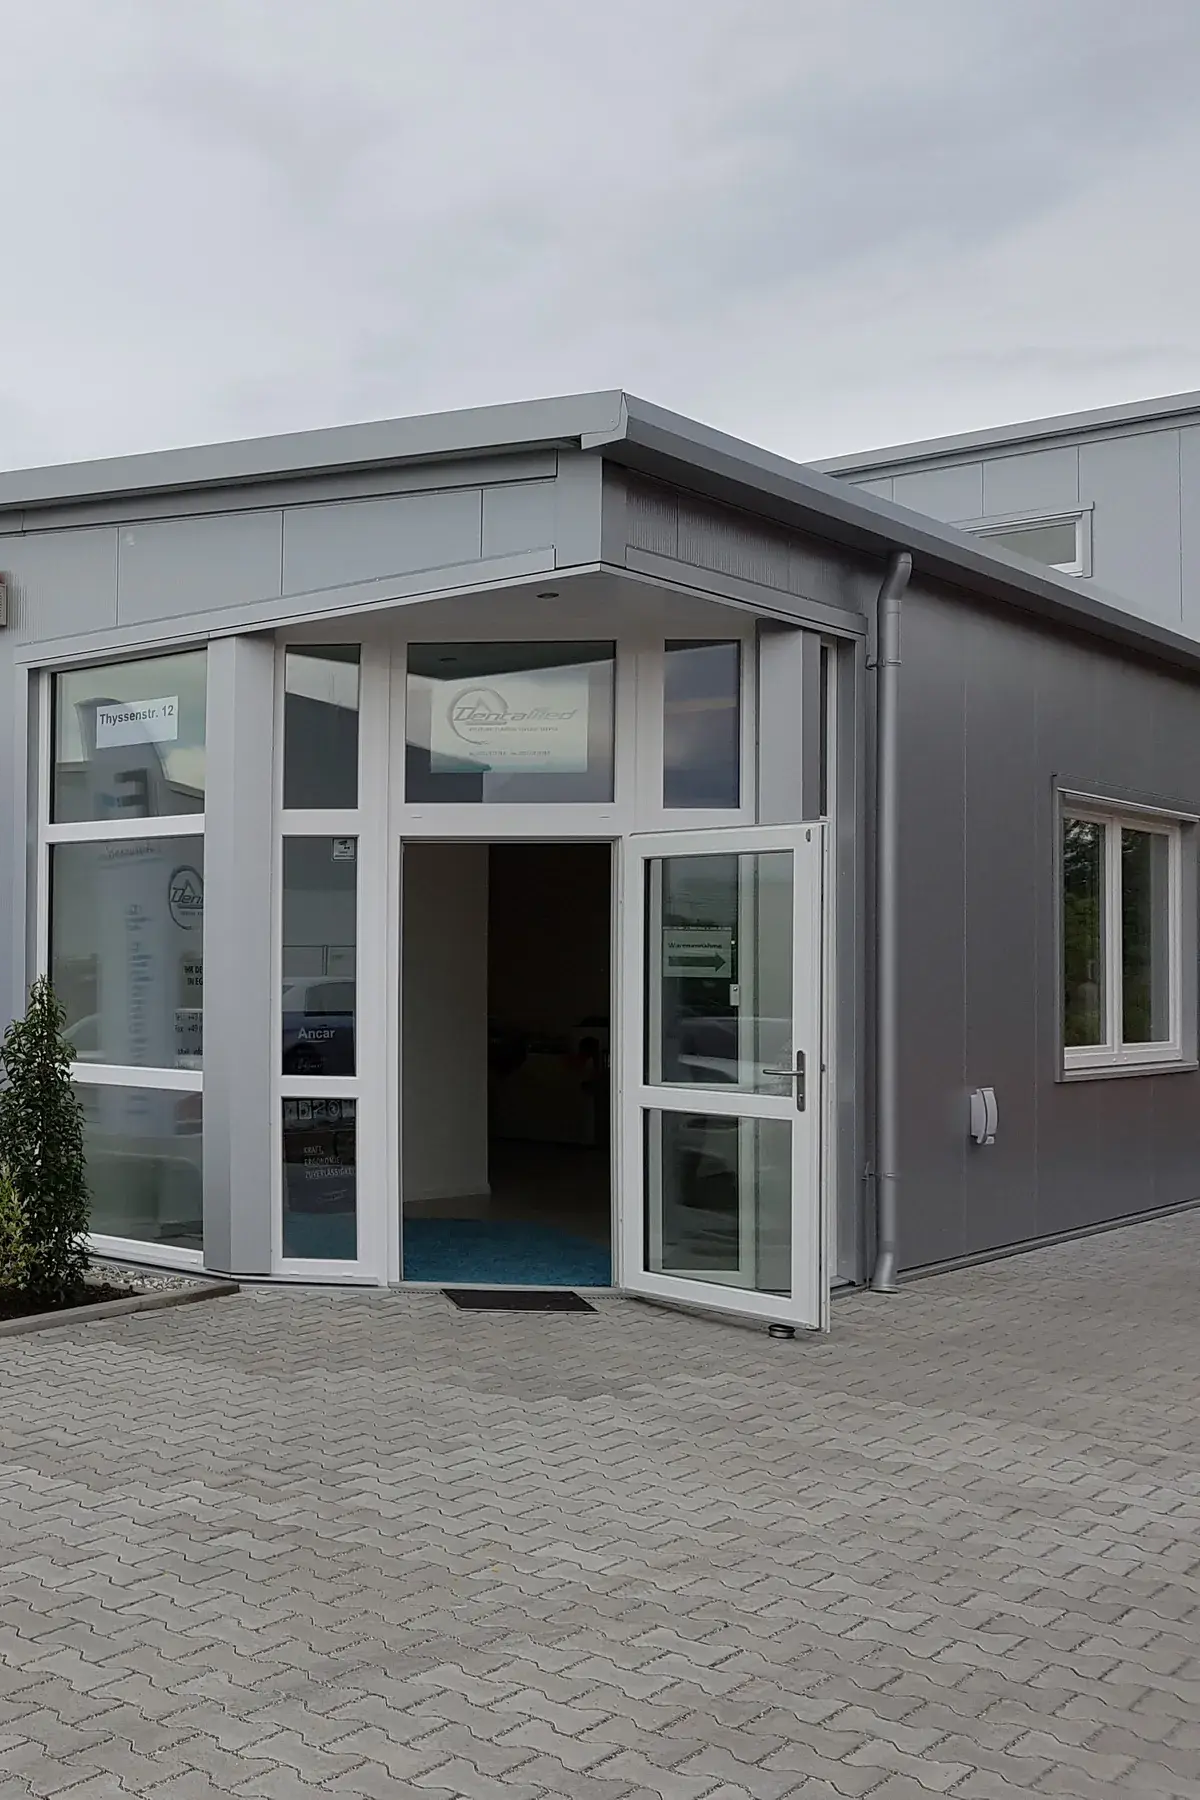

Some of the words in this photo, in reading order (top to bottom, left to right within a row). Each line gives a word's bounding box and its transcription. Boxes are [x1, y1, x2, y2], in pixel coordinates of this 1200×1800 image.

[99, 708, 159, 727] Thyssenstr.
[161, 704, 175, 717] 12
[298, 1026, 336, 1039] Ancar
